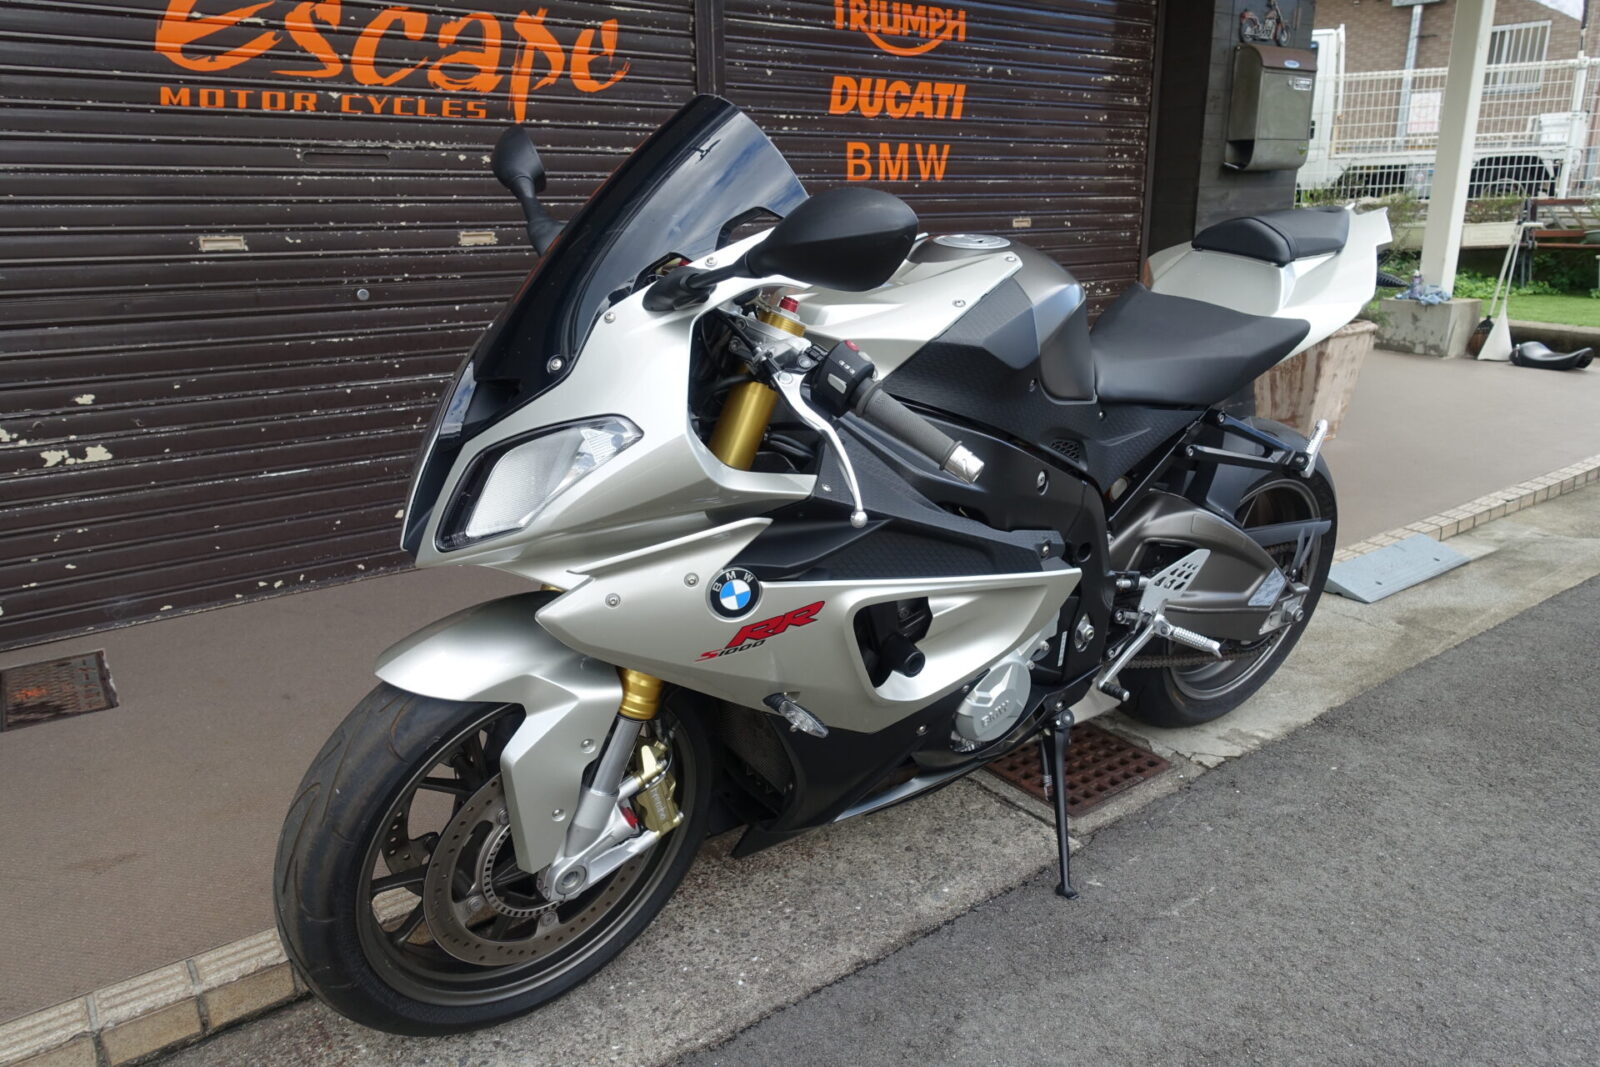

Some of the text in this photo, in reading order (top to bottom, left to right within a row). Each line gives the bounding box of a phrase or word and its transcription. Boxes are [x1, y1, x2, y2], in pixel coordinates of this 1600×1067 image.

[834, 0, 966, 43] TRIUMPH
[159, 86, 487, 120] MOTOR CYCLES
[828, 75, 966, 120] DUCATI
[846, 141, 950, 182] BMW
[712, 571, 754, 592] BMW
[694, 600, 826, 663] S1000 RR
